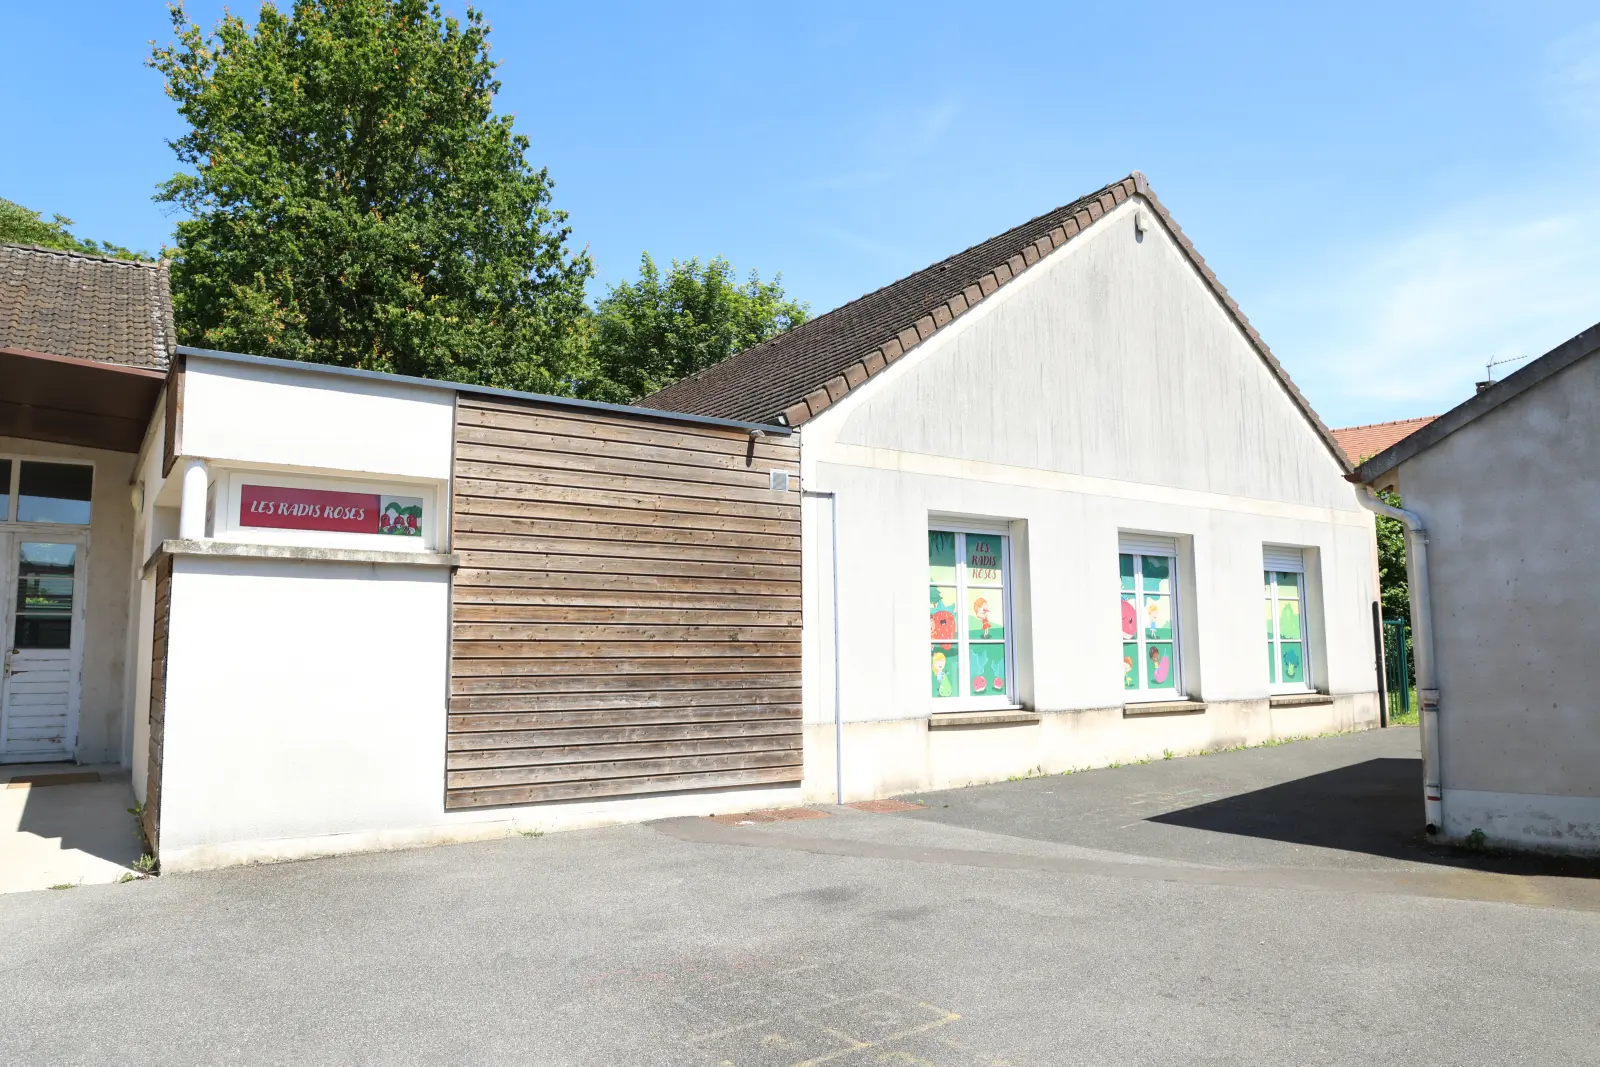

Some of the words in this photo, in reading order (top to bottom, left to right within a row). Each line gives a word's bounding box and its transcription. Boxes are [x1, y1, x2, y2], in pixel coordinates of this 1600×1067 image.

[250, 500, 275, 514] LES
[278, 502, 321, 517] RADIS
[324, 506, 365, 520] ROSES
[975, 542, 990, 552] LES
[971, 555, 996, 566] RADIS
[972, 568, 997, 579] ROSES
